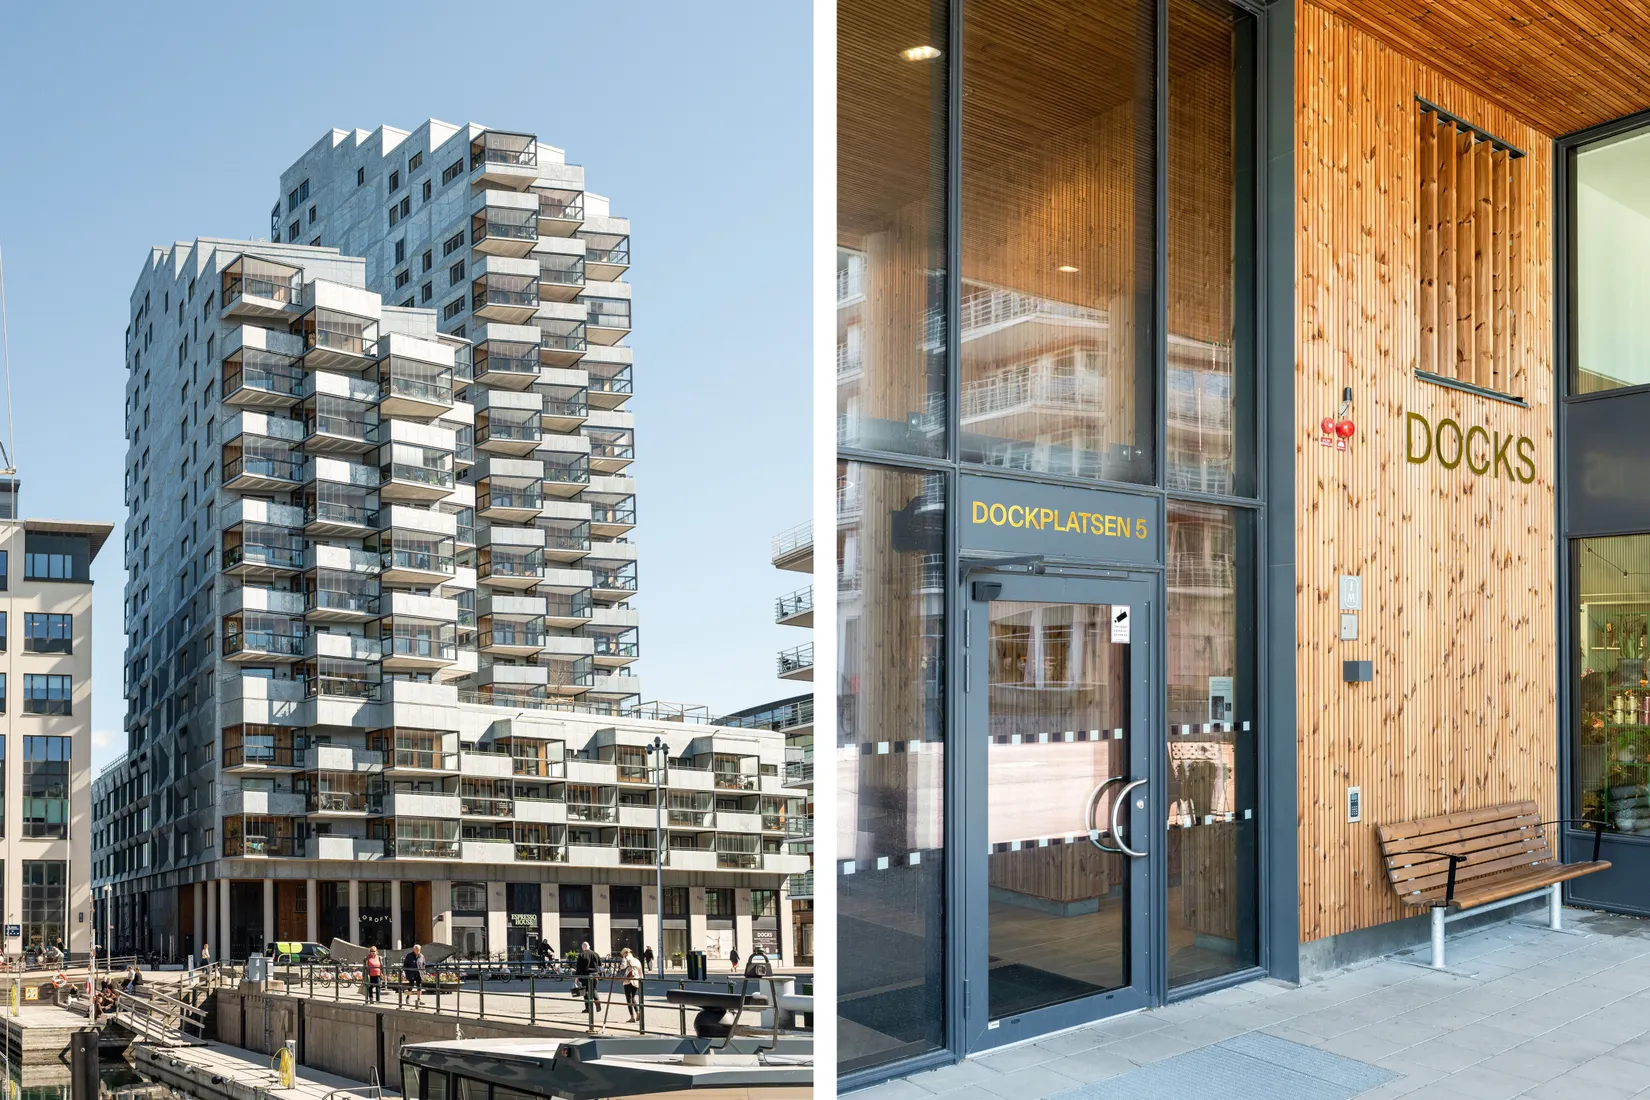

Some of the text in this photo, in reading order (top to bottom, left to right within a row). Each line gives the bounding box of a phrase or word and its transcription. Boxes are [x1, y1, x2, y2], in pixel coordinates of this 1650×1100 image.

[1406, 411, 1535, 484] DOCKS
[972, 501, 1147, 540] DOCKPLATSEN 5
